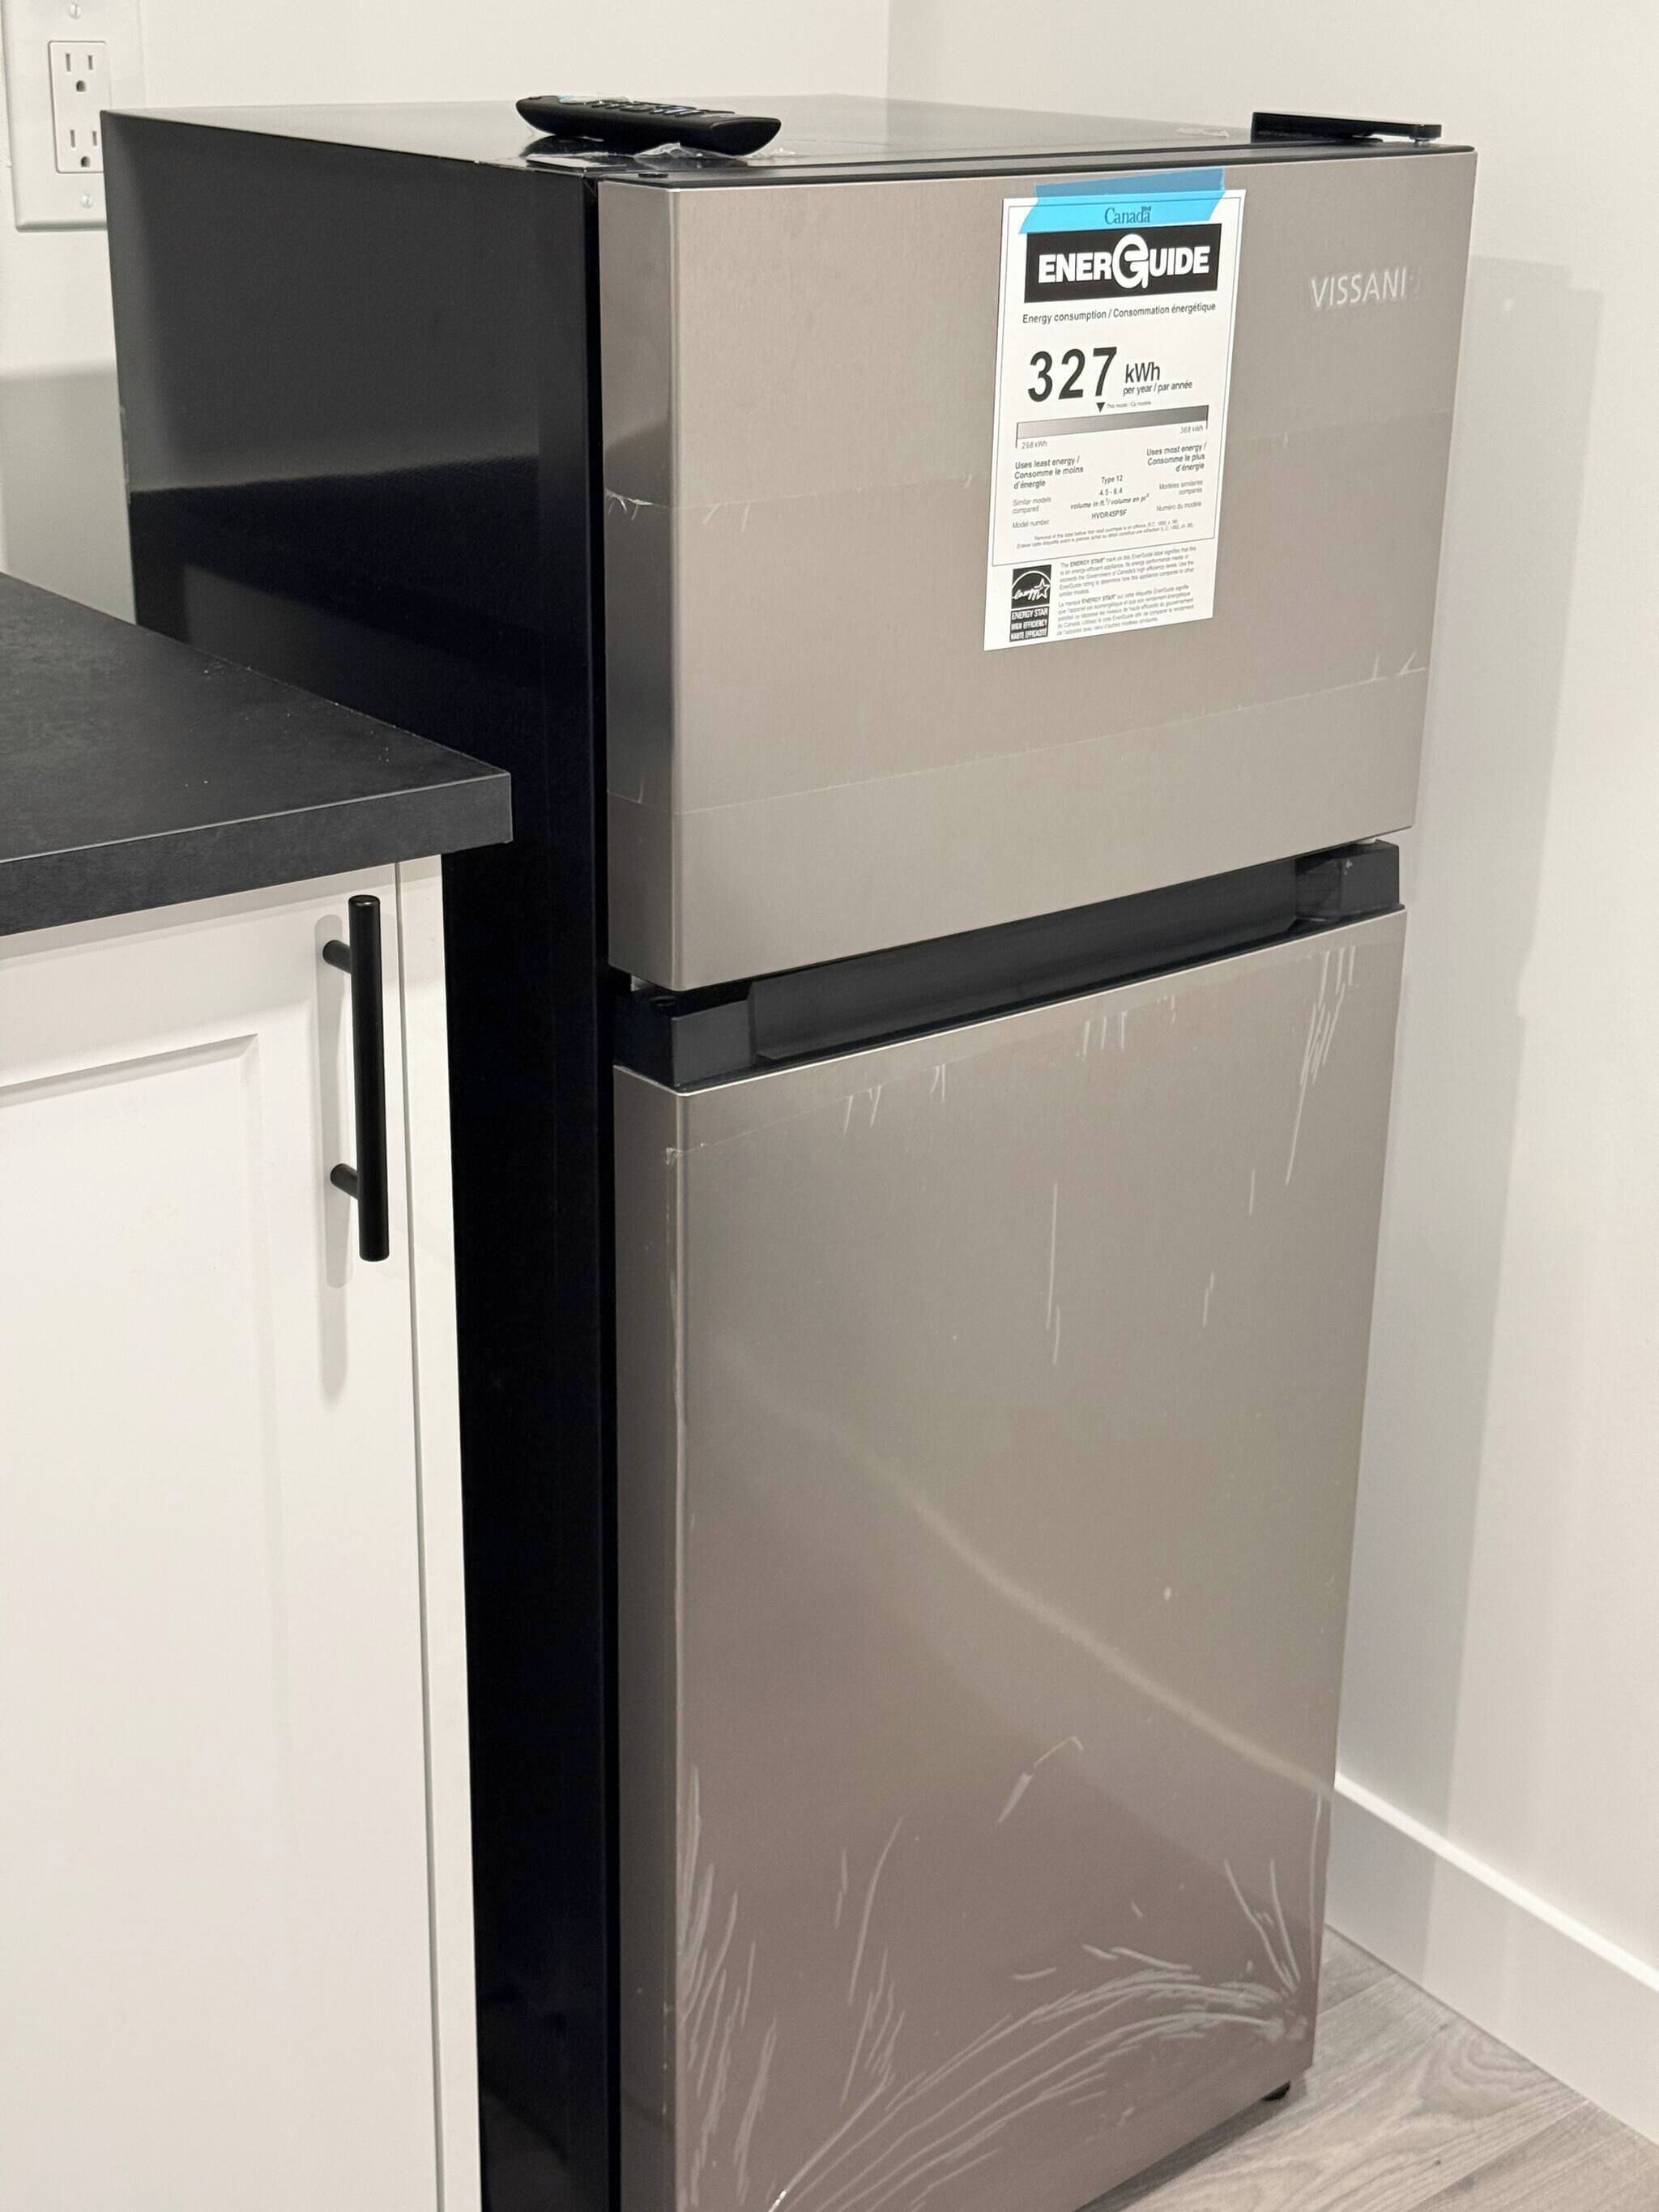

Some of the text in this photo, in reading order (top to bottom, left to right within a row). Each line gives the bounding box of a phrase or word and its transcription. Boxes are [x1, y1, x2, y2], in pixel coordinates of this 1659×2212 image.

[1104, 206, 1152, 224] Canada
[1311, 266, 1406, 308] VISSANI
[1022, 314, 1051, 325] Energy
[1054, 310, 1107, 322] consumption
[1113, 306, 1170, 318] Consommation
[1171, 302, 1216, 313] énergétique
[1028, 347, 1117, 403] 327
[1125, 361, 1160, 383] kWh
[1123, 386, 1136, 396] per
[1137, 385, 1152, 395] year
[1158, 382, 1170, 393] par
[1171, 380, 1192, 390] année
[1147, 448, 1162, 456] Uses
[1164, 445, 1179, 454] most
[1181, 444, 1202, 452] energy
[1034, 459, 1050, 467] least
[1052, 458, 1075, 466] energy
[1148, 455, 1183, 466] Consomme
[1192, 453, 1205, 461] plus
[1014, 470, 1053, 479] Consomme
[1063, 467, 1084, 475] moins
[1102, 476, 1115, 484] Type
[1011, 609, 1034, 620] ENERGY
[1034, 608, 1048, 617] STAR
